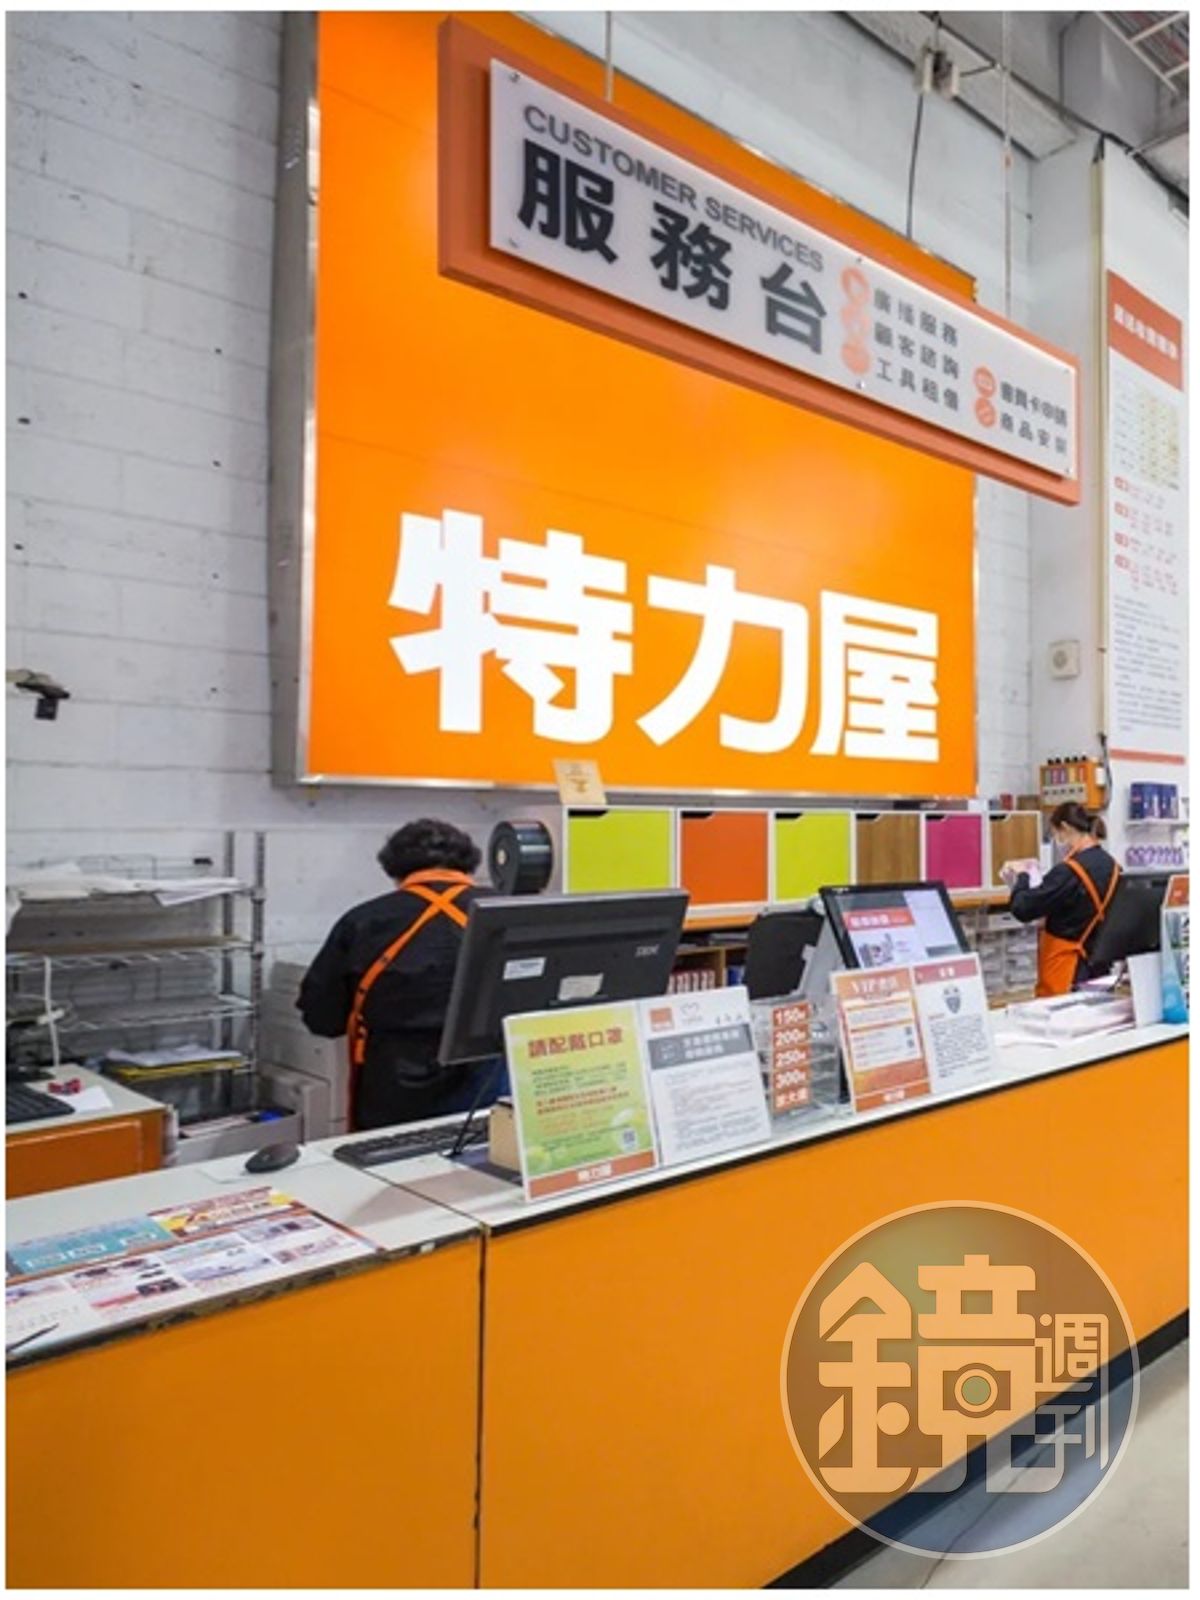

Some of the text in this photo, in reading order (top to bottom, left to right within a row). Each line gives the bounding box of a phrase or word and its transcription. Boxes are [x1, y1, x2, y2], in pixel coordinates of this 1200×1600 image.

[517, 138, 826, 355] 服務台
[523, 104, 824, 273] CUSTOMER SERVICES
[388, 508, 939, 762] 特力屋
[527, 1027, 623, 1059] 請配戴口罩
